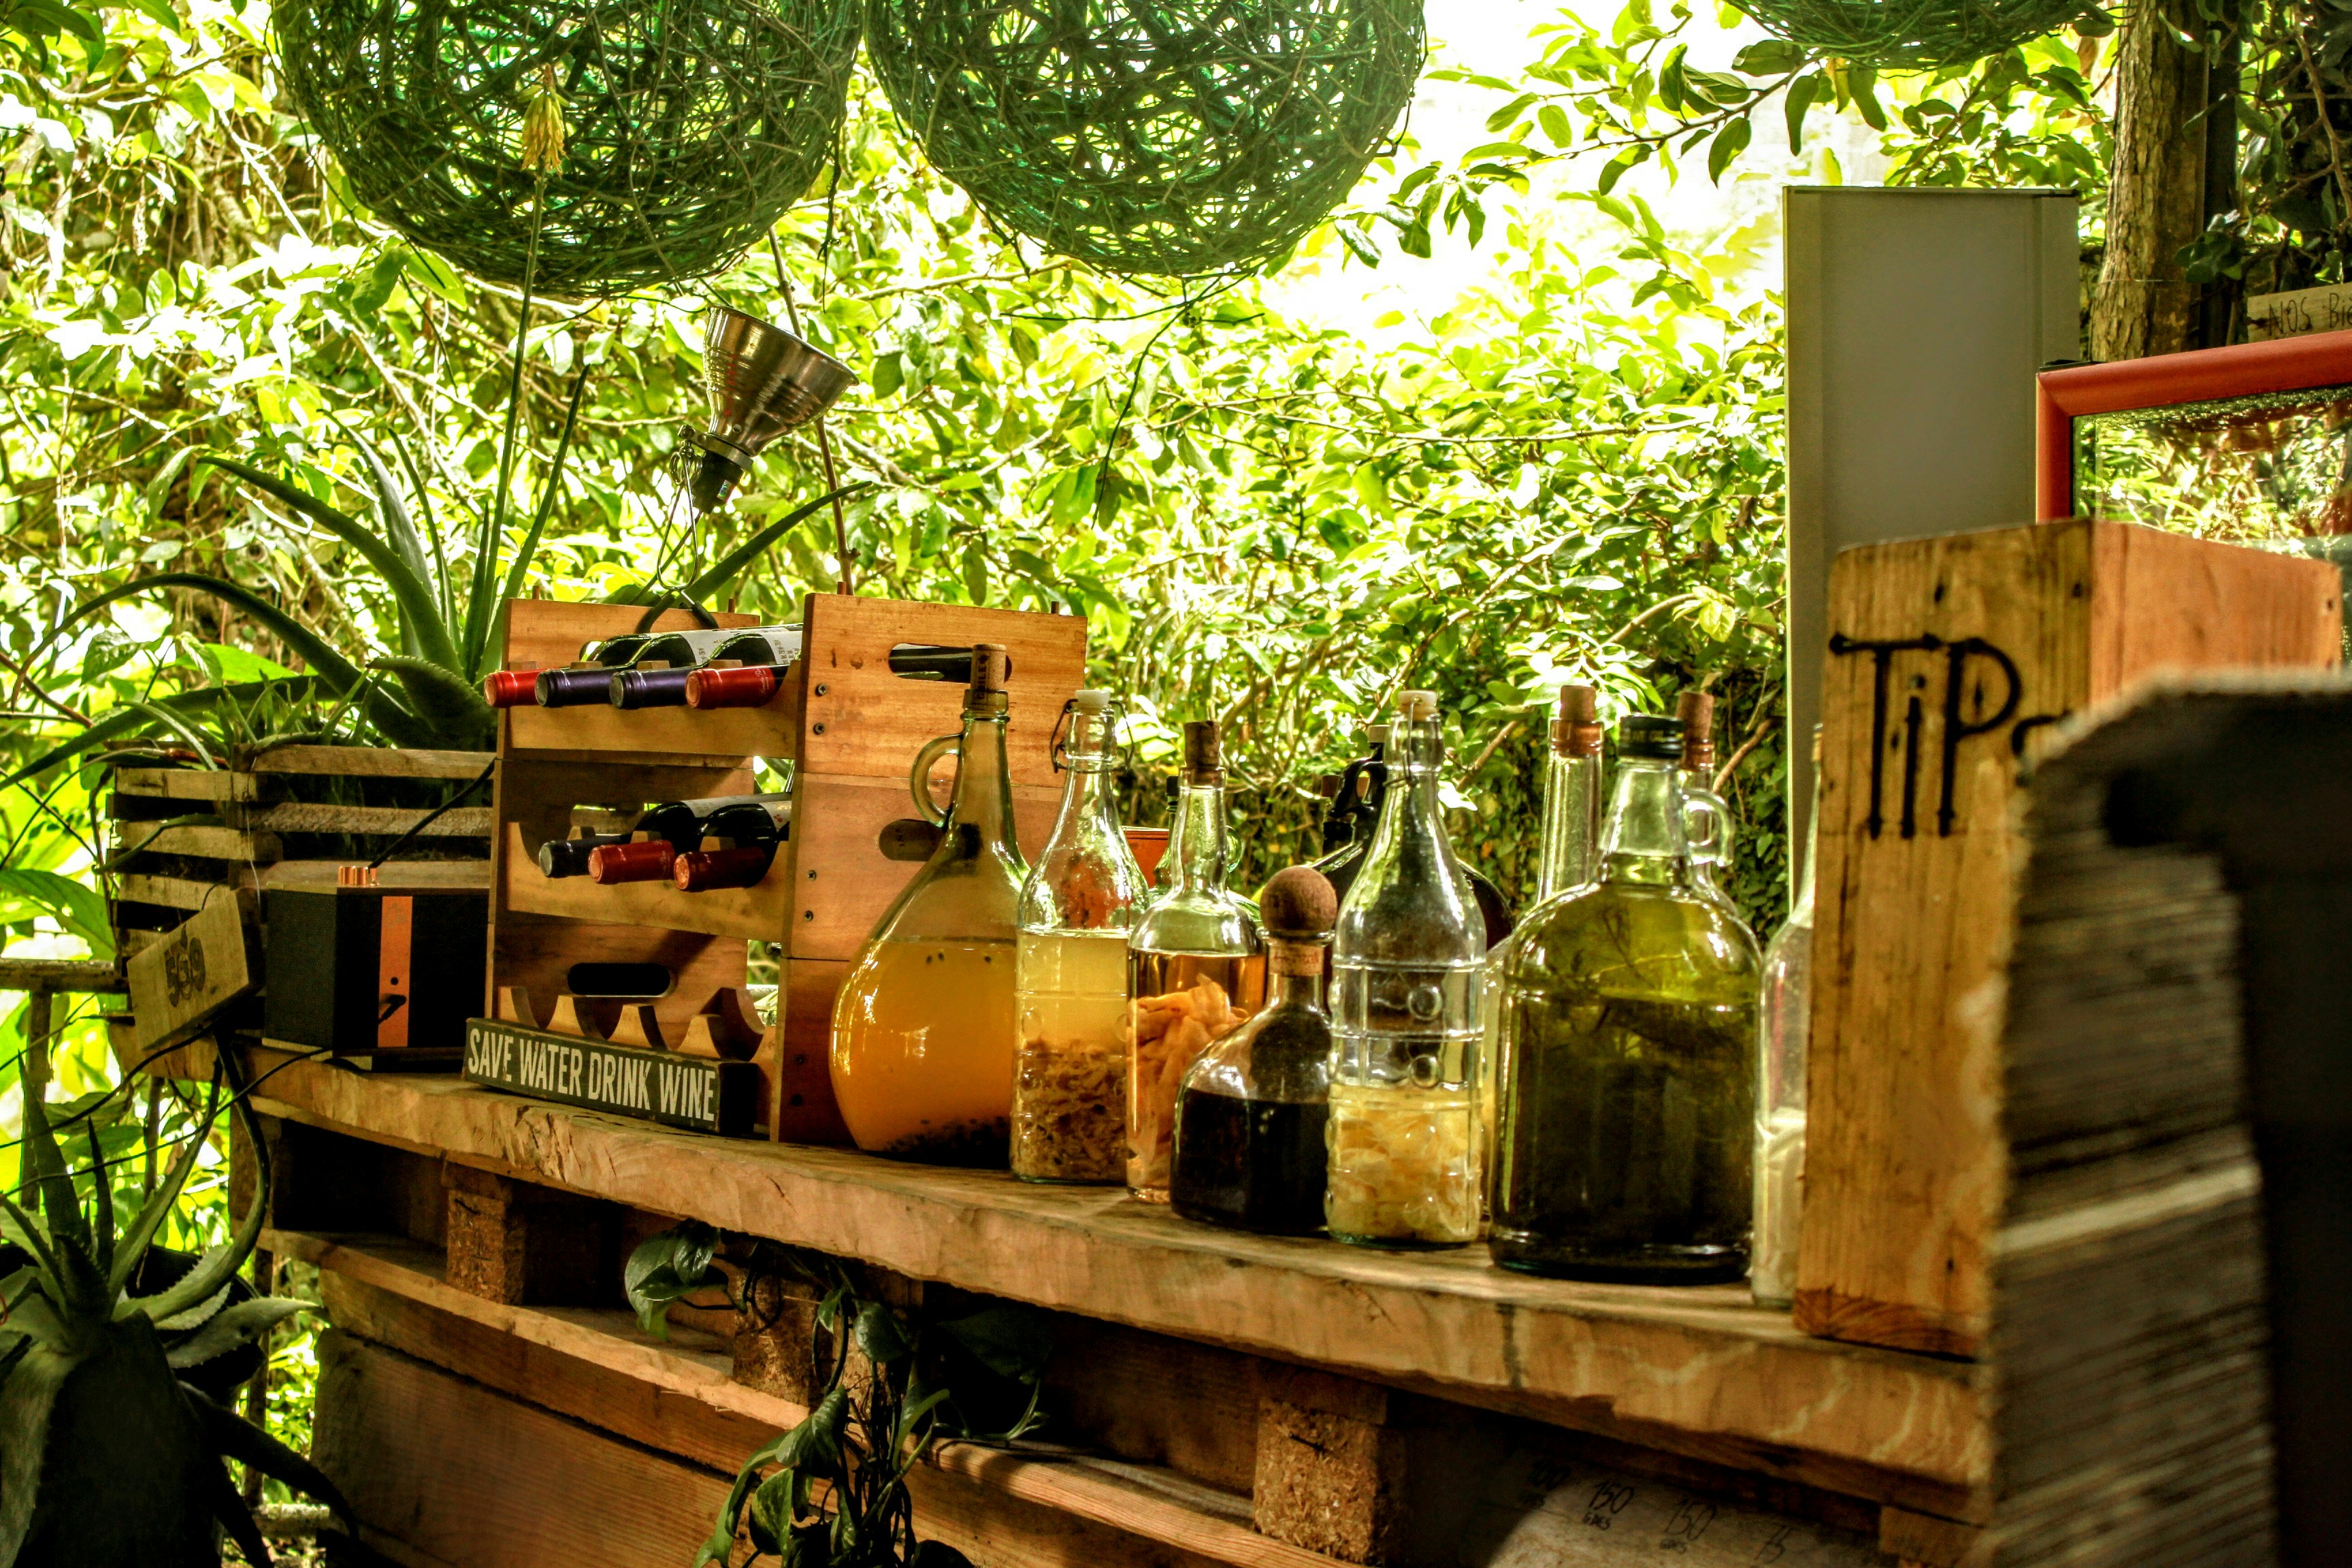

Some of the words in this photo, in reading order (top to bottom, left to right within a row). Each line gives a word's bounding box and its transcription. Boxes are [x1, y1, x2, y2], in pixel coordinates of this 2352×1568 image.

[2268, 296, 2311, 336] NOS
[468, 1028, 512, 1082] SAVE
[519, 1039, 583, 1097] WATER
[588, 1051, 651, 1110] DRINK
[659, 1062, 716, 1122] WINE
[1588, 1480, 1635, 1514] 150
[1663, 1497, 1717, 1541] 150
